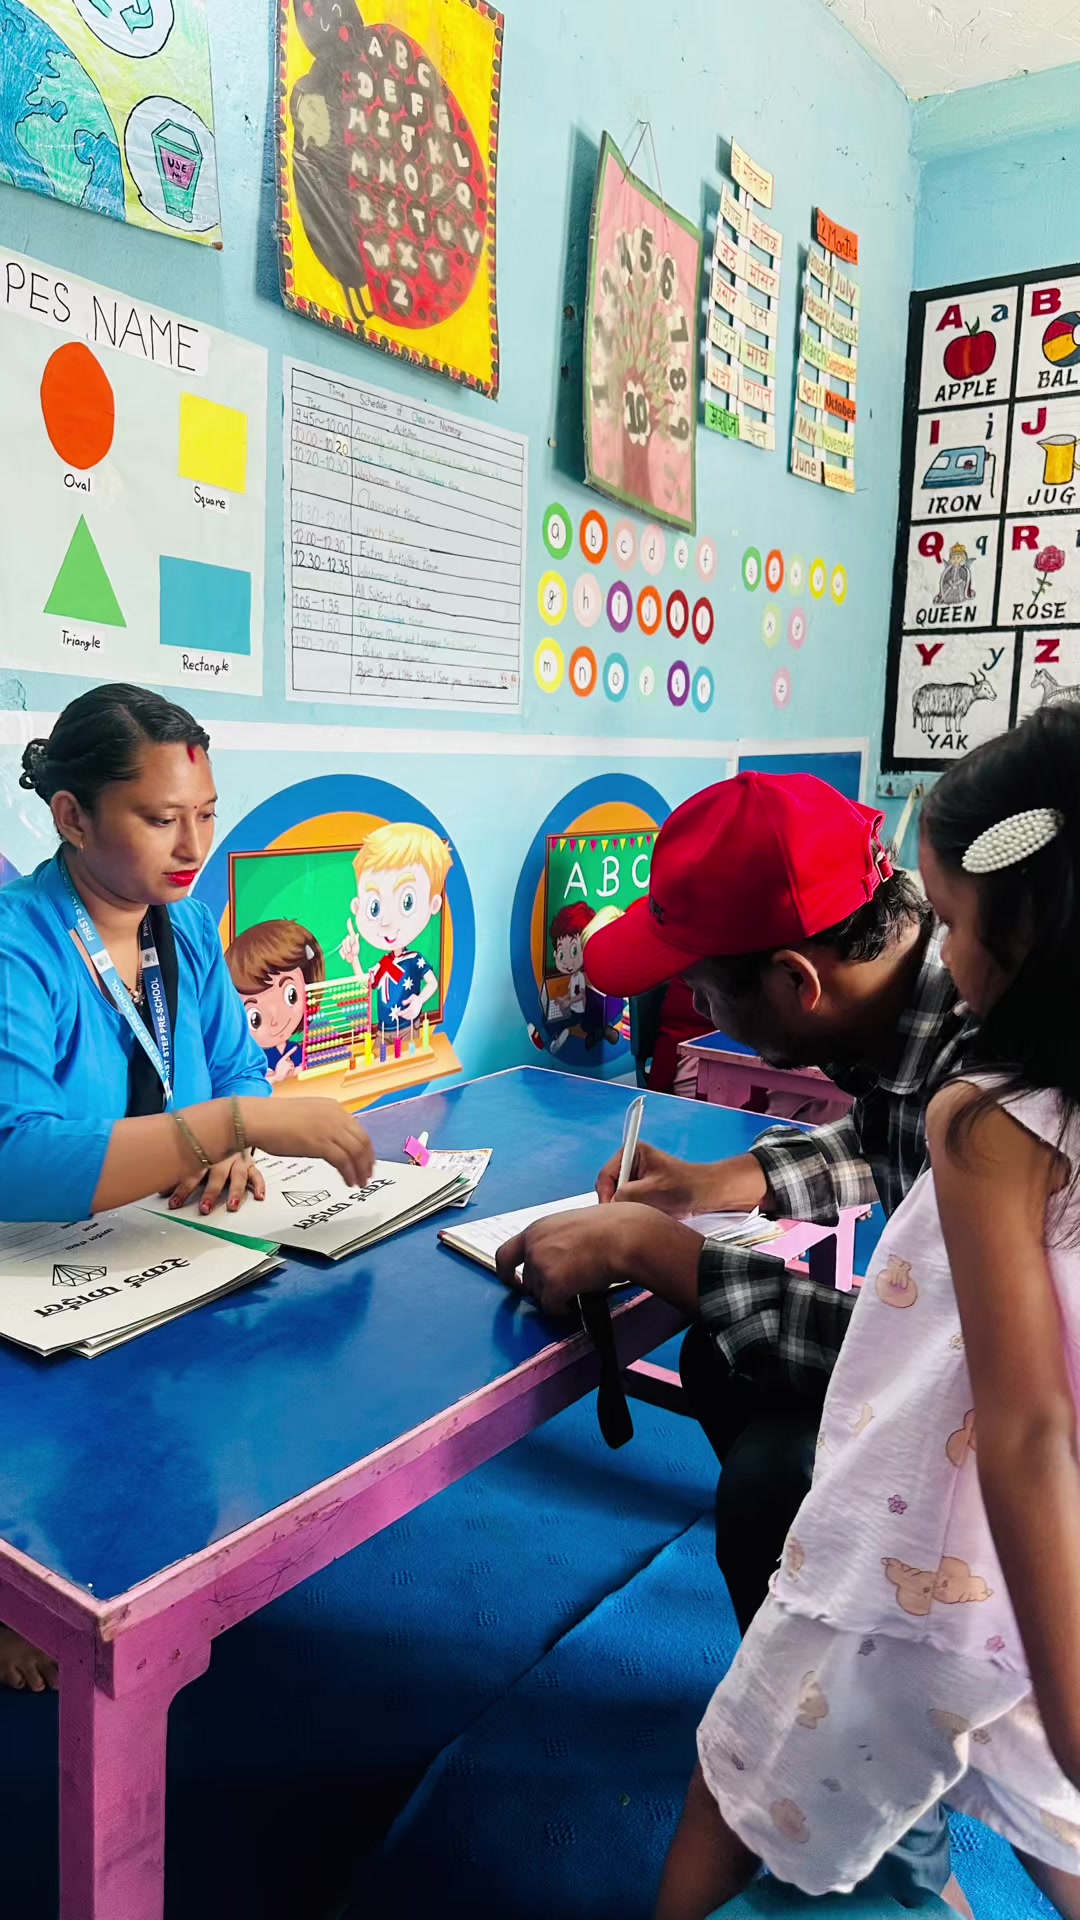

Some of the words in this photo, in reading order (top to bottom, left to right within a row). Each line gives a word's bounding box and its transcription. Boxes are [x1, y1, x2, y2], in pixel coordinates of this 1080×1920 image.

[368, 37, 383, 57] A
[395, 40, 408, 69] B
[418, 62, 431, 88] C
[358, 72, 373, 98] D
[384, 79, 397, 103] E
[411, 92, 423, 116] F
[348, 108, 367, 133] H
[378, 109, 390, 137] I
[401, 124, 415, 152] J
[427, 138, 442, 164] K
[453, 142, 470, 167] L
[168, 158, 187, 173] USE
[351, 152, 368, 176] M
[379, 158, 396, 184] N
[404, 164, 418, 191] O
[430, 173, 444, 197] P
[456, 182, 472, 209] Q
[387, 199, 398, 228] S
[412, 208, 425, 232] T
[437, 218, 454, 240] U
[463, 228, 480, 254] V
[363, 241, 390, 266] W
[396, 242, 418, 269] X
[428, 253, 444, 280] Y
[640, 229, 653, 273] 5
[391, 278, 408, 306] Z
[660, 257, 674, 300] 6
[836, 274, 856, 305] July
[1030, 288, 1062, 317] B
[5, 262, 71, 322] PES
[92, 295, 199, 372] NAME
[831, 312, 858, 343] August
[936, 304, 963, 332] A
[991, 303, 1009, 323] a
[670, 368, 687, 392] 8
[803, 379, 822, 404] April
[935, 378, 997, 402] APPLE
[626, 392, 648, 435] 10
[826, 391, 856, 420] October
[670, 416, 690, 441] 9
[798, 416, 816, 446] May
[930, 420, 940, 446] I
[986, 412, 994, 440] i
[1021, 406, 1047, 436] J
[795, 450, 816, 477] June
[63, 473, 92, 492] Oval
[1028, 486, 1076, 506] JUG
[193, 486, 226, 509] Square
[928, 494, 982, 514] IRON
[918, 531, 944, 564] Q
[976, 534, 988, 556] q
[1012, 526, 1039, 550] R
[916, 605, 977, 627] QUEEN
[1012, 602, 1067, 621] ROSE
[62, 629, 101, 652] Triangle
[1034, 638, 1060, 664] Z
[182, 654, 230, 676] Rectangle
[915, 642, 944, 666] Y
[982, 647, 1004, 670] y
[927, 734, 969, 750] YAK
[78, 916, 96, 942] FIRST
[150, 977, 171, 1034] PRE-SCHOOL
[161, 1034, 172, 1059] STEP
